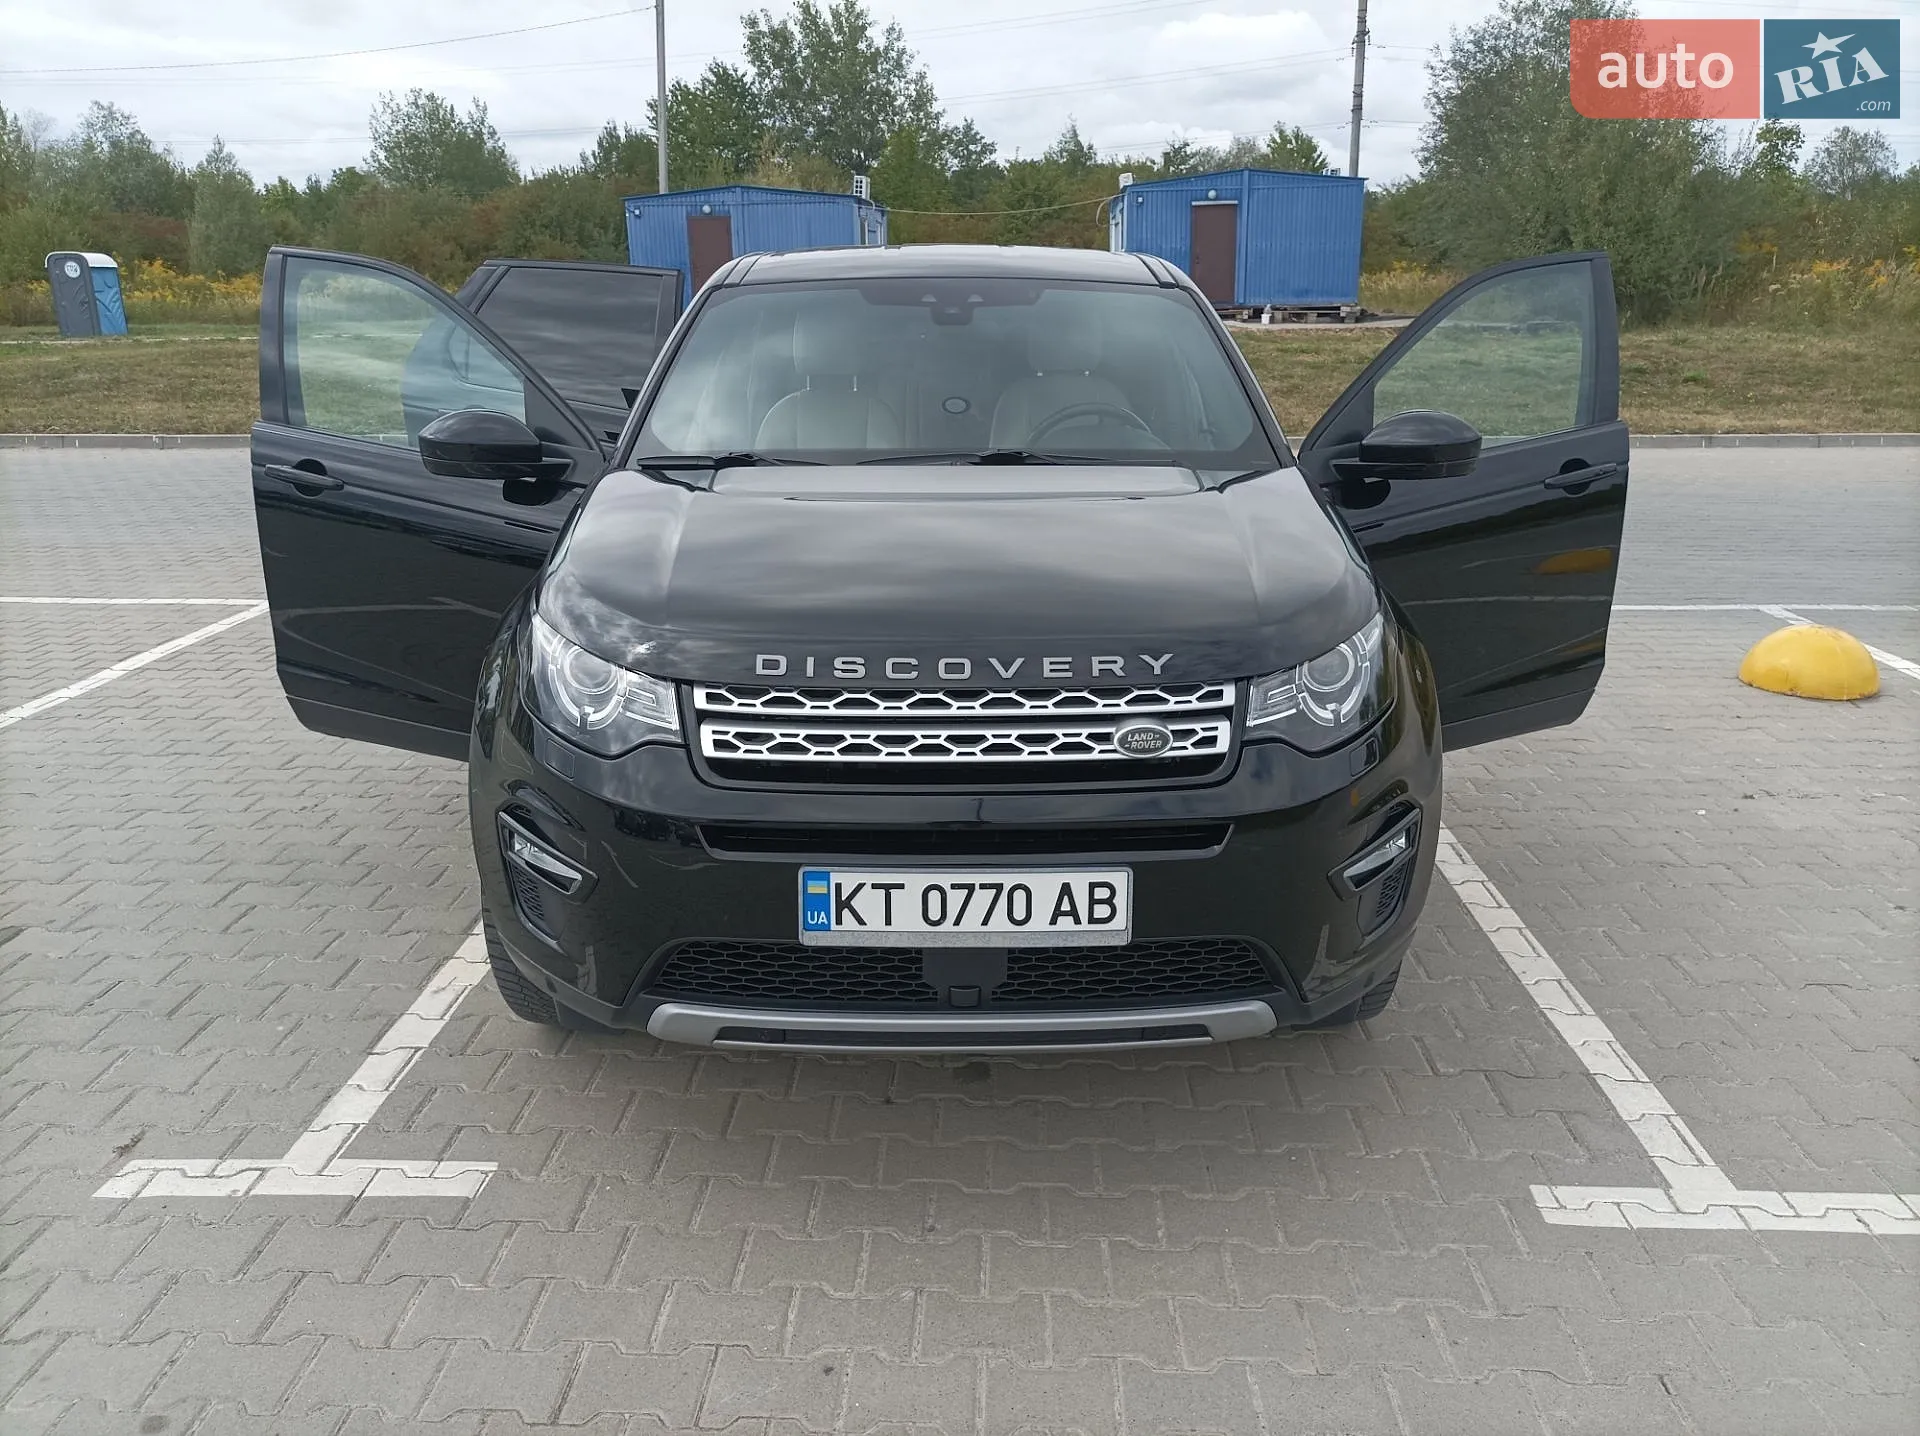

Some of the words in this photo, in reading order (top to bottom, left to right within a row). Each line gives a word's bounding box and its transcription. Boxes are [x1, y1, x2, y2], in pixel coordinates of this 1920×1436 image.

[755, 653, 1174, 680] DISCOVERY
[834, 882, 905, 927] KT
[921, 883, 1033, 927] 0770
[1048, 881, 1118, 926] AB
[807, 911, 828, 925] UA
